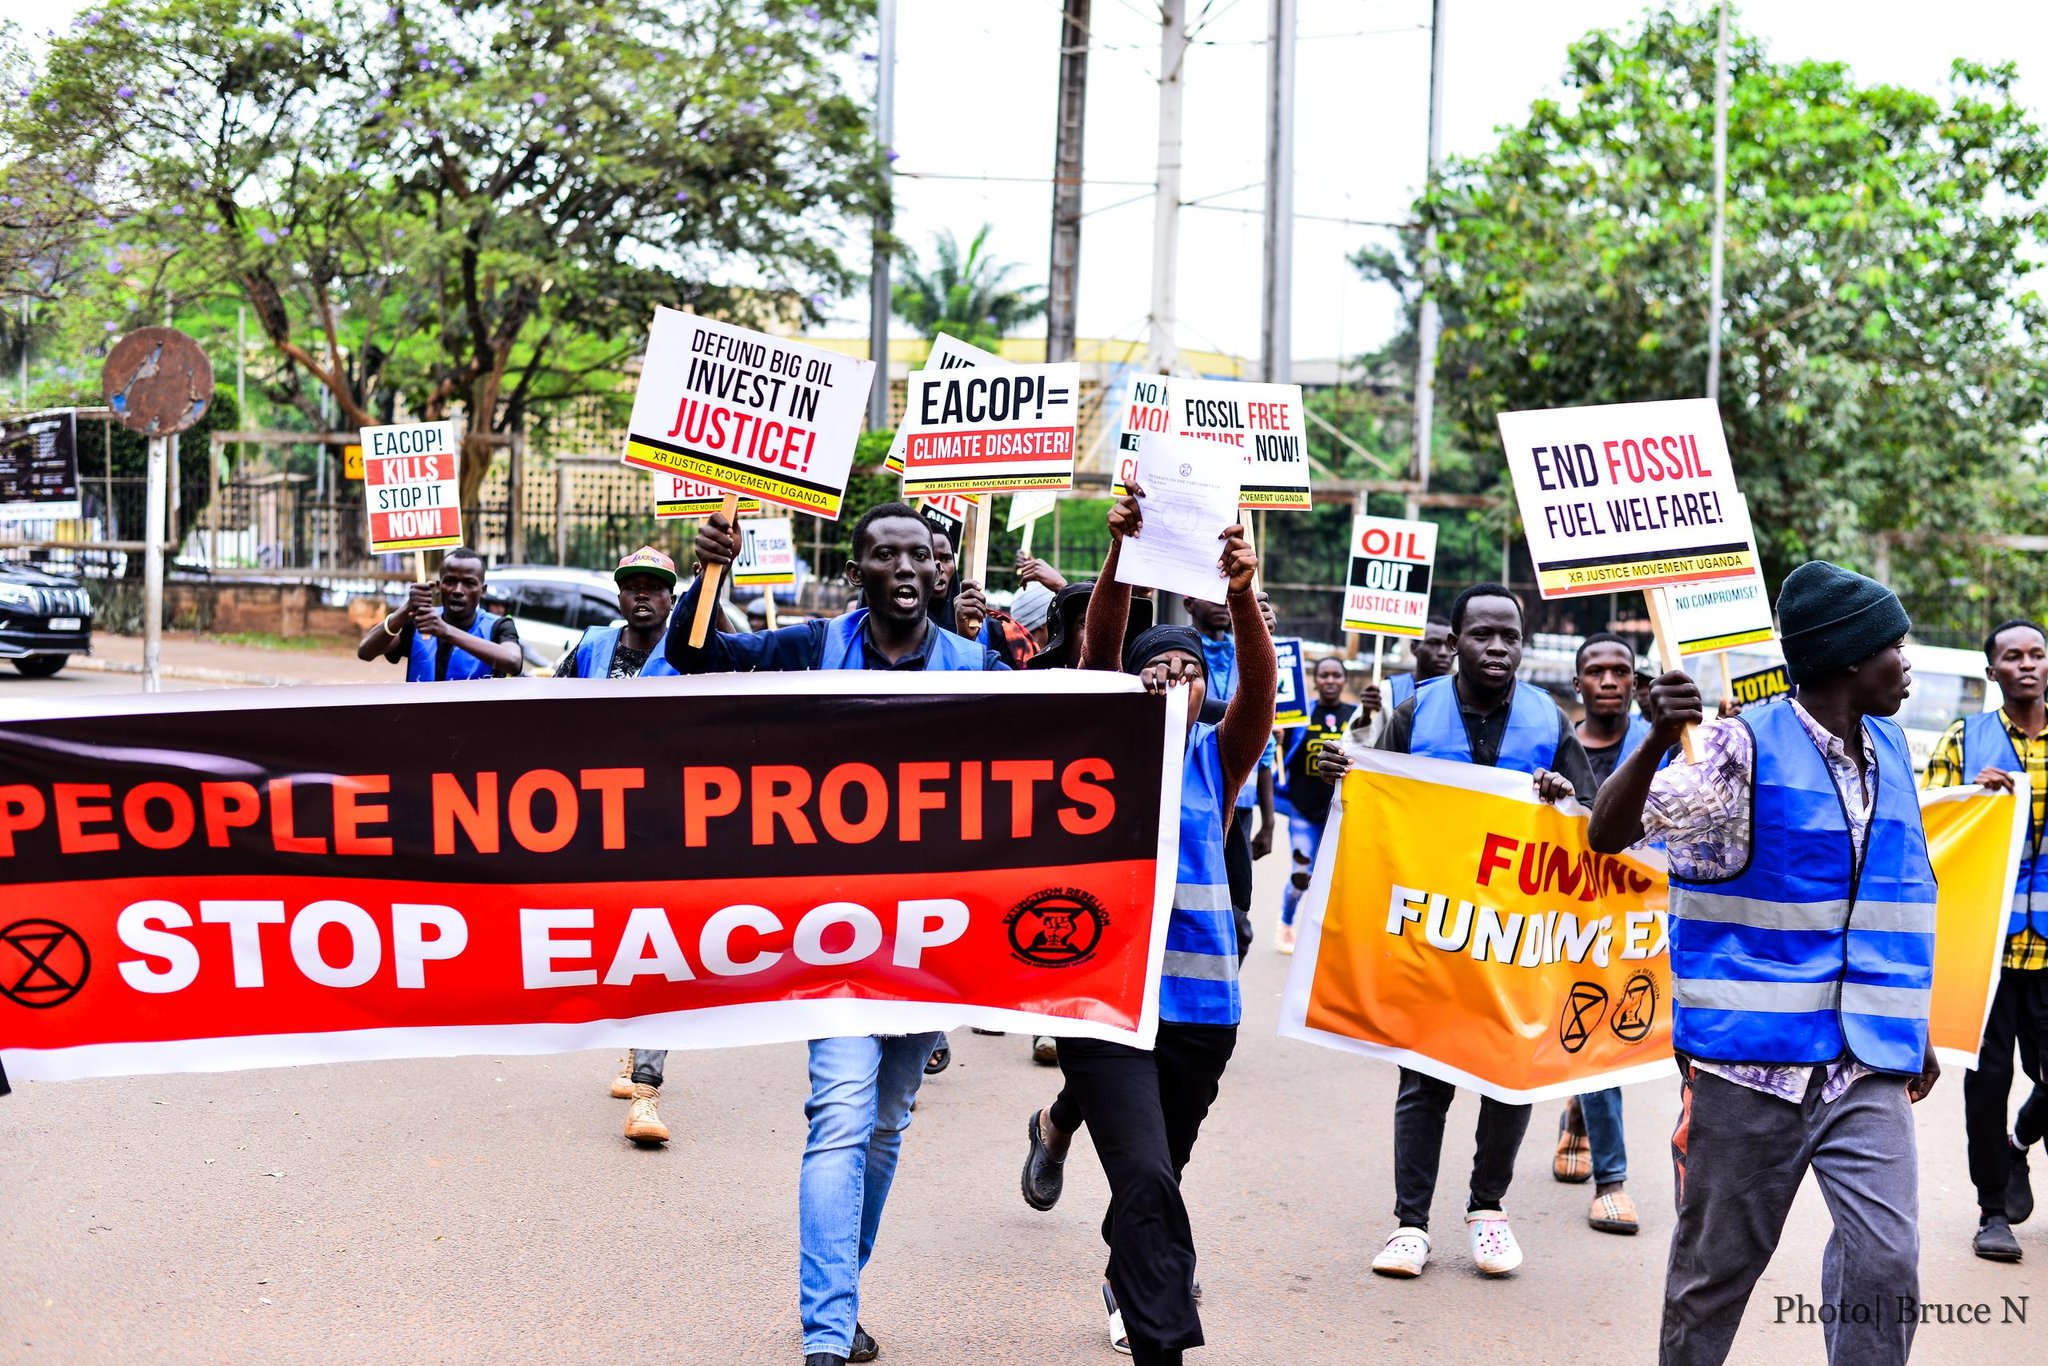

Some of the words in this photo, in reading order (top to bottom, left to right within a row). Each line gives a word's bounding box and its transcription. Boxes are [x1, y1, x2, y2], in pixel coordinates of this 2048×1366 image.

[691, 328, 767, 368] DEFUND
[769, 349, 802, 378] BIG
[805, 359, 834, 388] OIL
[686, 357, 786, 412] INVEST
[788, 384, 820, 422] IN
[1134, 381, 1157, 404] NO
[1185, 398, 1245, 429] FOSSIL
[1247, 402, 1290, 430] FREE
[373, 428, 443, 456] EACOP!
[667, 397, 817, 473] JUSTICE!
[913, 434, 981, 460] CLIMATE
[985, 431, 1070, 456] DISASTER!
[1255, 434, 1300, 463] NOW!
[382, 456, 440, 485] KILLS
[652, 450, 669, 463] XR
[669, 454, 713, 475] JUSTICE
[715, 464, 780, 493] MOVEMENT
[780, 483, 828, 506] UGANDA
[1531, 443, 1599, 491] END
[1602, 434, 1713, 485] FOSSIL
[379, 486, 422, 509] STOP
[427, 485, 442, 506] IT
[935, 481, 971, 489] JUSTICE
[972, 479, 1022, 487] MOVEMENT
[1023, 477, 1063, 485] UGANDA
[1239, 493, 1273, 502] OVEMENT
[1274, 494, 1304, 502] UGANDA
[387, 509, 443, 539] NOW!
[677, 504, 699, 512] JUSTICE
[1544, 502, 1606, 539] FUEL
[1606, 490, 1724, 533] WELFARE!
[1361, 528, 1425, 560] OIL
[1365, 560, 1413, 592] OUT
[1568, 572, 1584, 584] XR
[1587, 566, 1631, 582] JUSTICE
[1632, 560, 1694, 576] MOVEMENT
[1697, 555, 1743, 570] UGANDA
[1351, 594, 1401, 614] JUSTICE
[1404, 600, 1424, 616] IN!
[1676, 597, 1690, 611] NO
[1692, 585, 1759, 608] COMPROMISE!
[1733, 669, 1790, 705] TOTAL
[0, 774, 394, 858] PEOPLE
[431, 767, 645, 855] NOT
[683, 757, 1117, 848] PROFITS
[1066, 887, 1112, 926] REBELLION
[1385, 883, 1613, 968] FUNDING
[116, 900, 469, 994] STOP
[519, 898, 971, 990] EACOP
